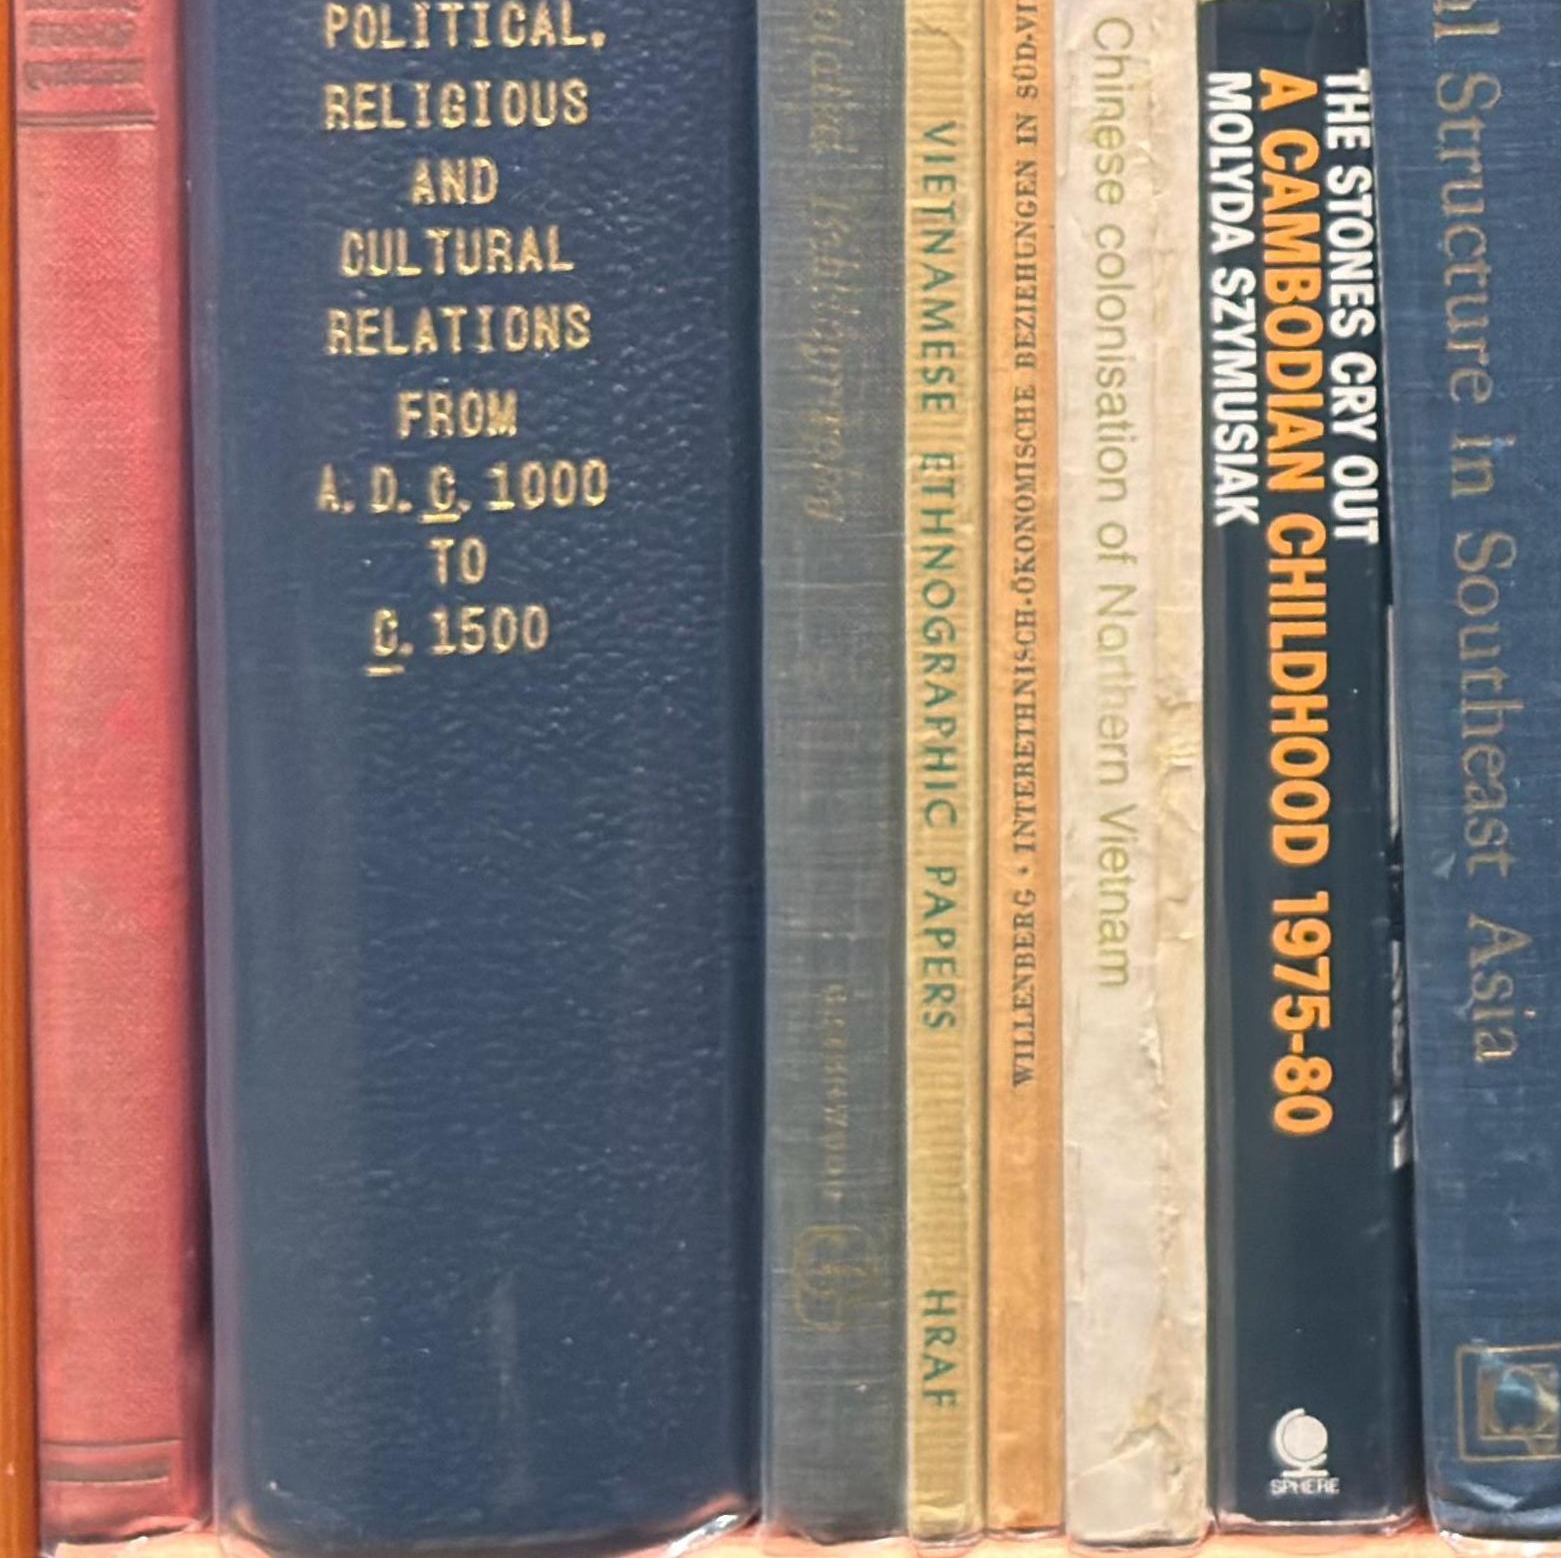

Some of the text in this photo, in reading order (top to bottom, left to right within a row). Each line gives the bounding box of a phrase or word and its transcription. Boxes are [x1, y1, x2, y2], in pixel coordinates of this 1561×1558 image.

[410, 156, 500, 206] AND
[1324, 68, 1380, 544] THE STONES CRY OUT
[920, 121, 957, 1030] VIETNAMESE ETHNOGRAPHIC PAPERS
[1093, 17, 1138, 987] Chinese colonisation of Northern Vietnam
[1259, 68, 1333, 1136] A CAMBODIAN CHILDHOOD 1975-80
[921, 1288, 957, 1410] HRAF
[1270, 1477, 1341, 1496] SPHERE
